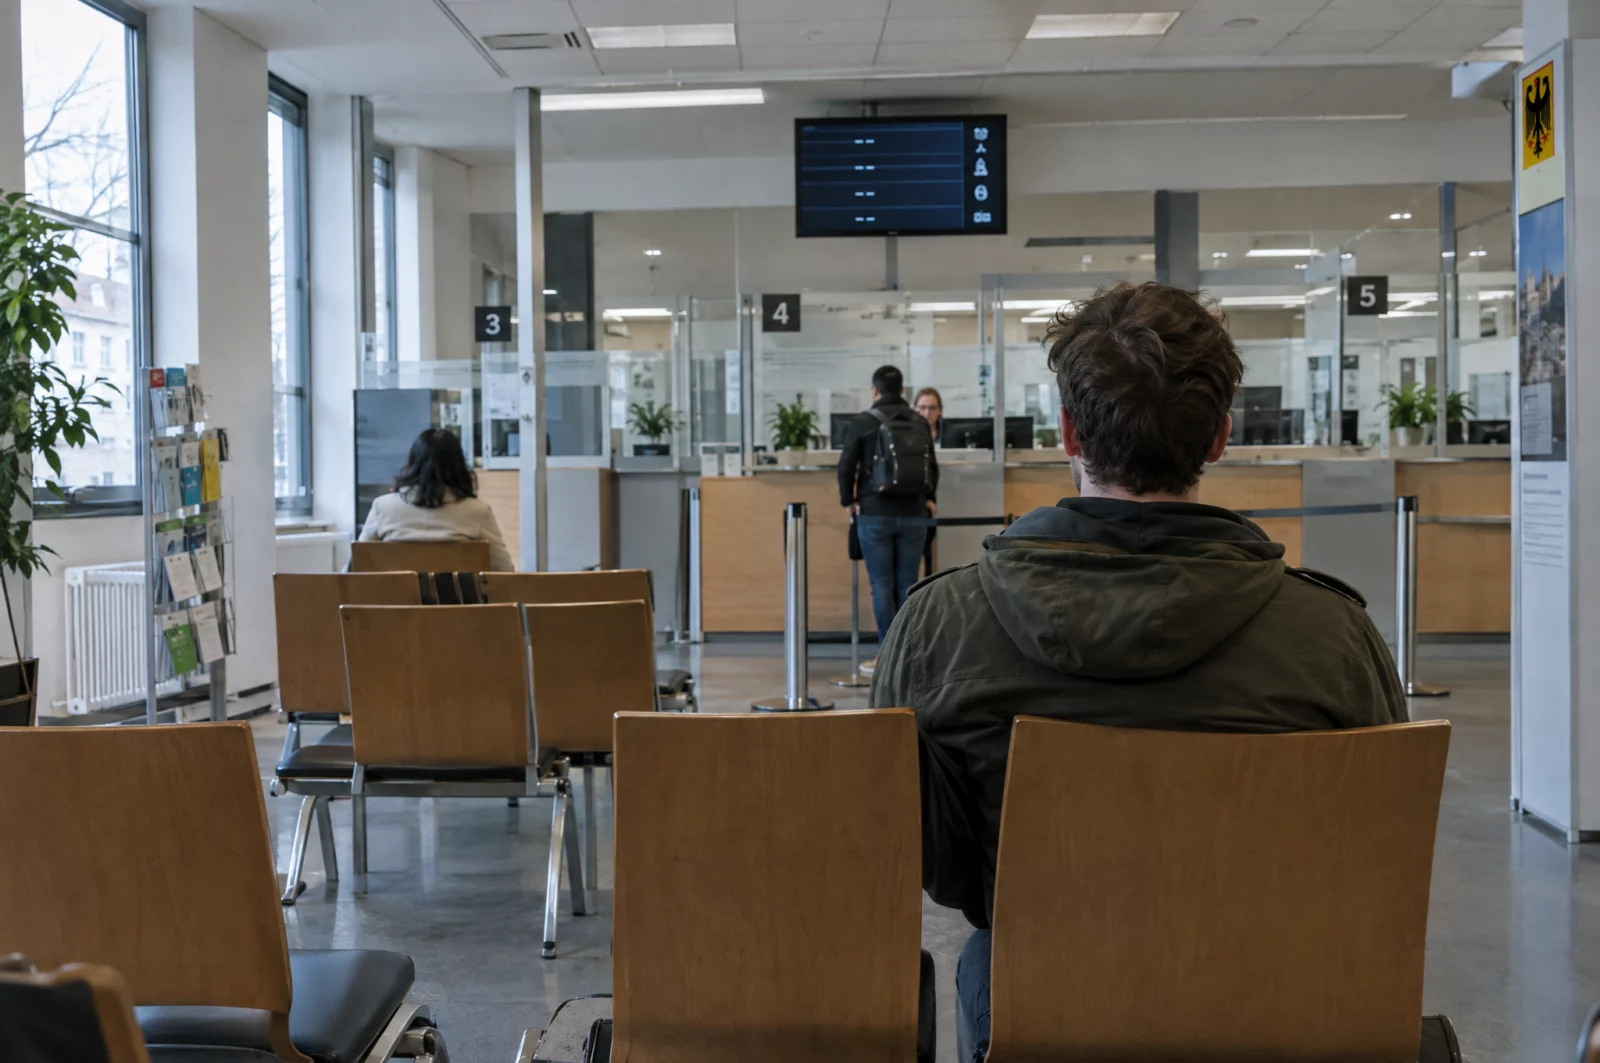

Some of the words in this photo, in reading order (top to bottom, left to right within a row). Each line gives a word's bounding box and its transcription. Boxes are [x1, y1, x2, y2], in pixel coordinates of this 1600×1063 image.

[1359, 284, 1376, 308] 5
[485, 313, 501, 335] 3
[772, 301, 790, 325] 4
